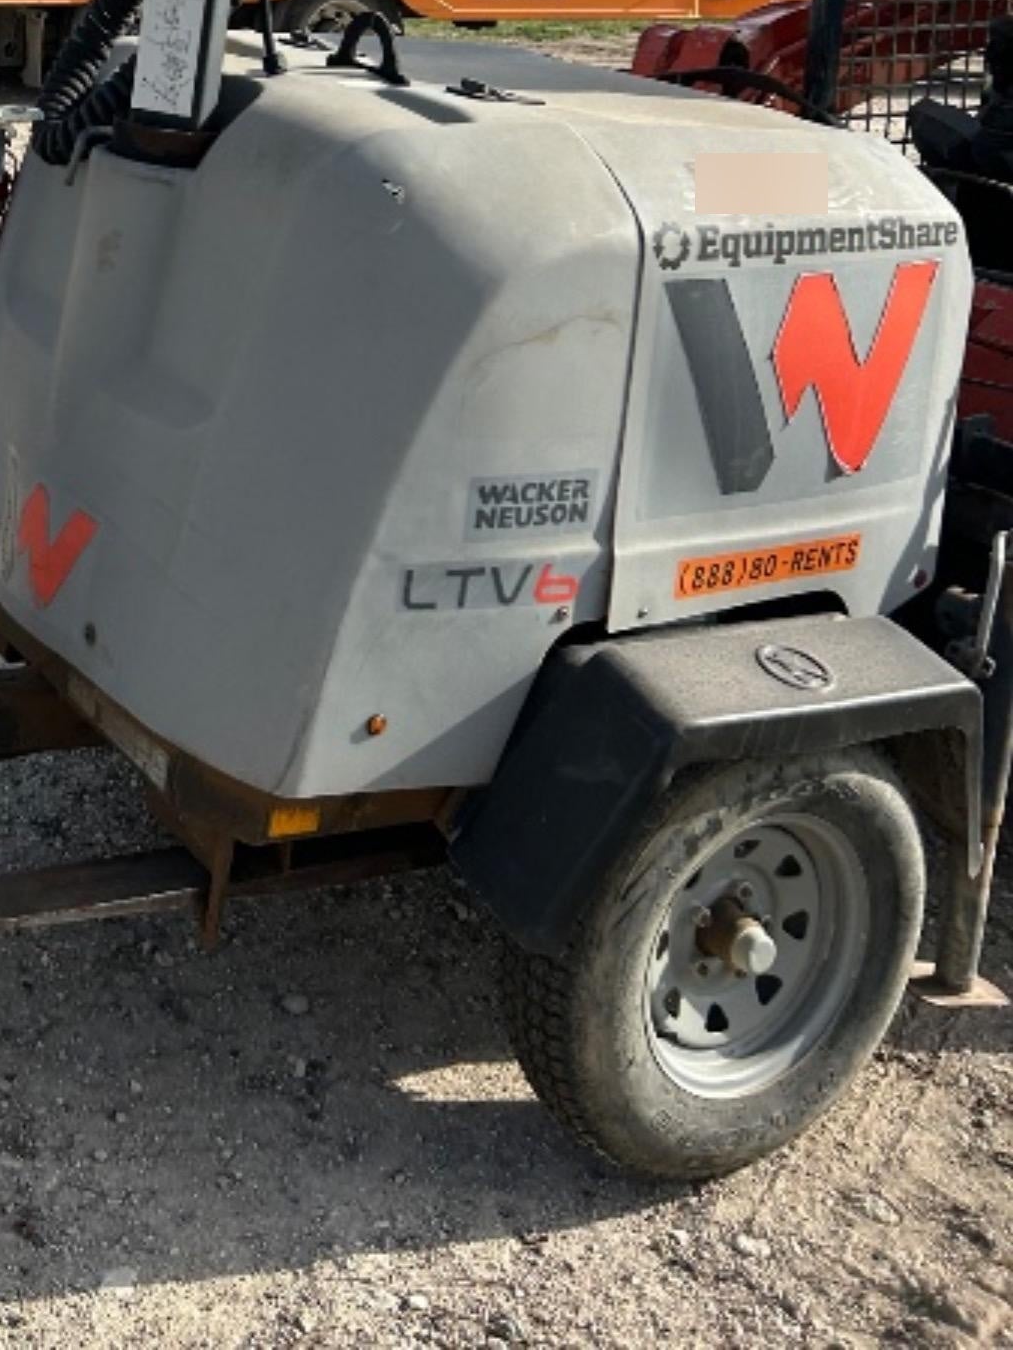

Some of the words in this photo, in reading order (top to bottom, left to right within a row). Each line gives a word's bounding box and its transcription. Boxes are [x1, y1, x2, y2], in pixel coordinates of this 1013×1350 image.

[696, 217, 957, 267] EquipmentShare
[478, 478, 590, 505] WACKER
[475, 502, 588, 529] NEUSON
[403, 562, 580, 609] LTV6
[679, 540, 858, 594] (888)80-RENTS
